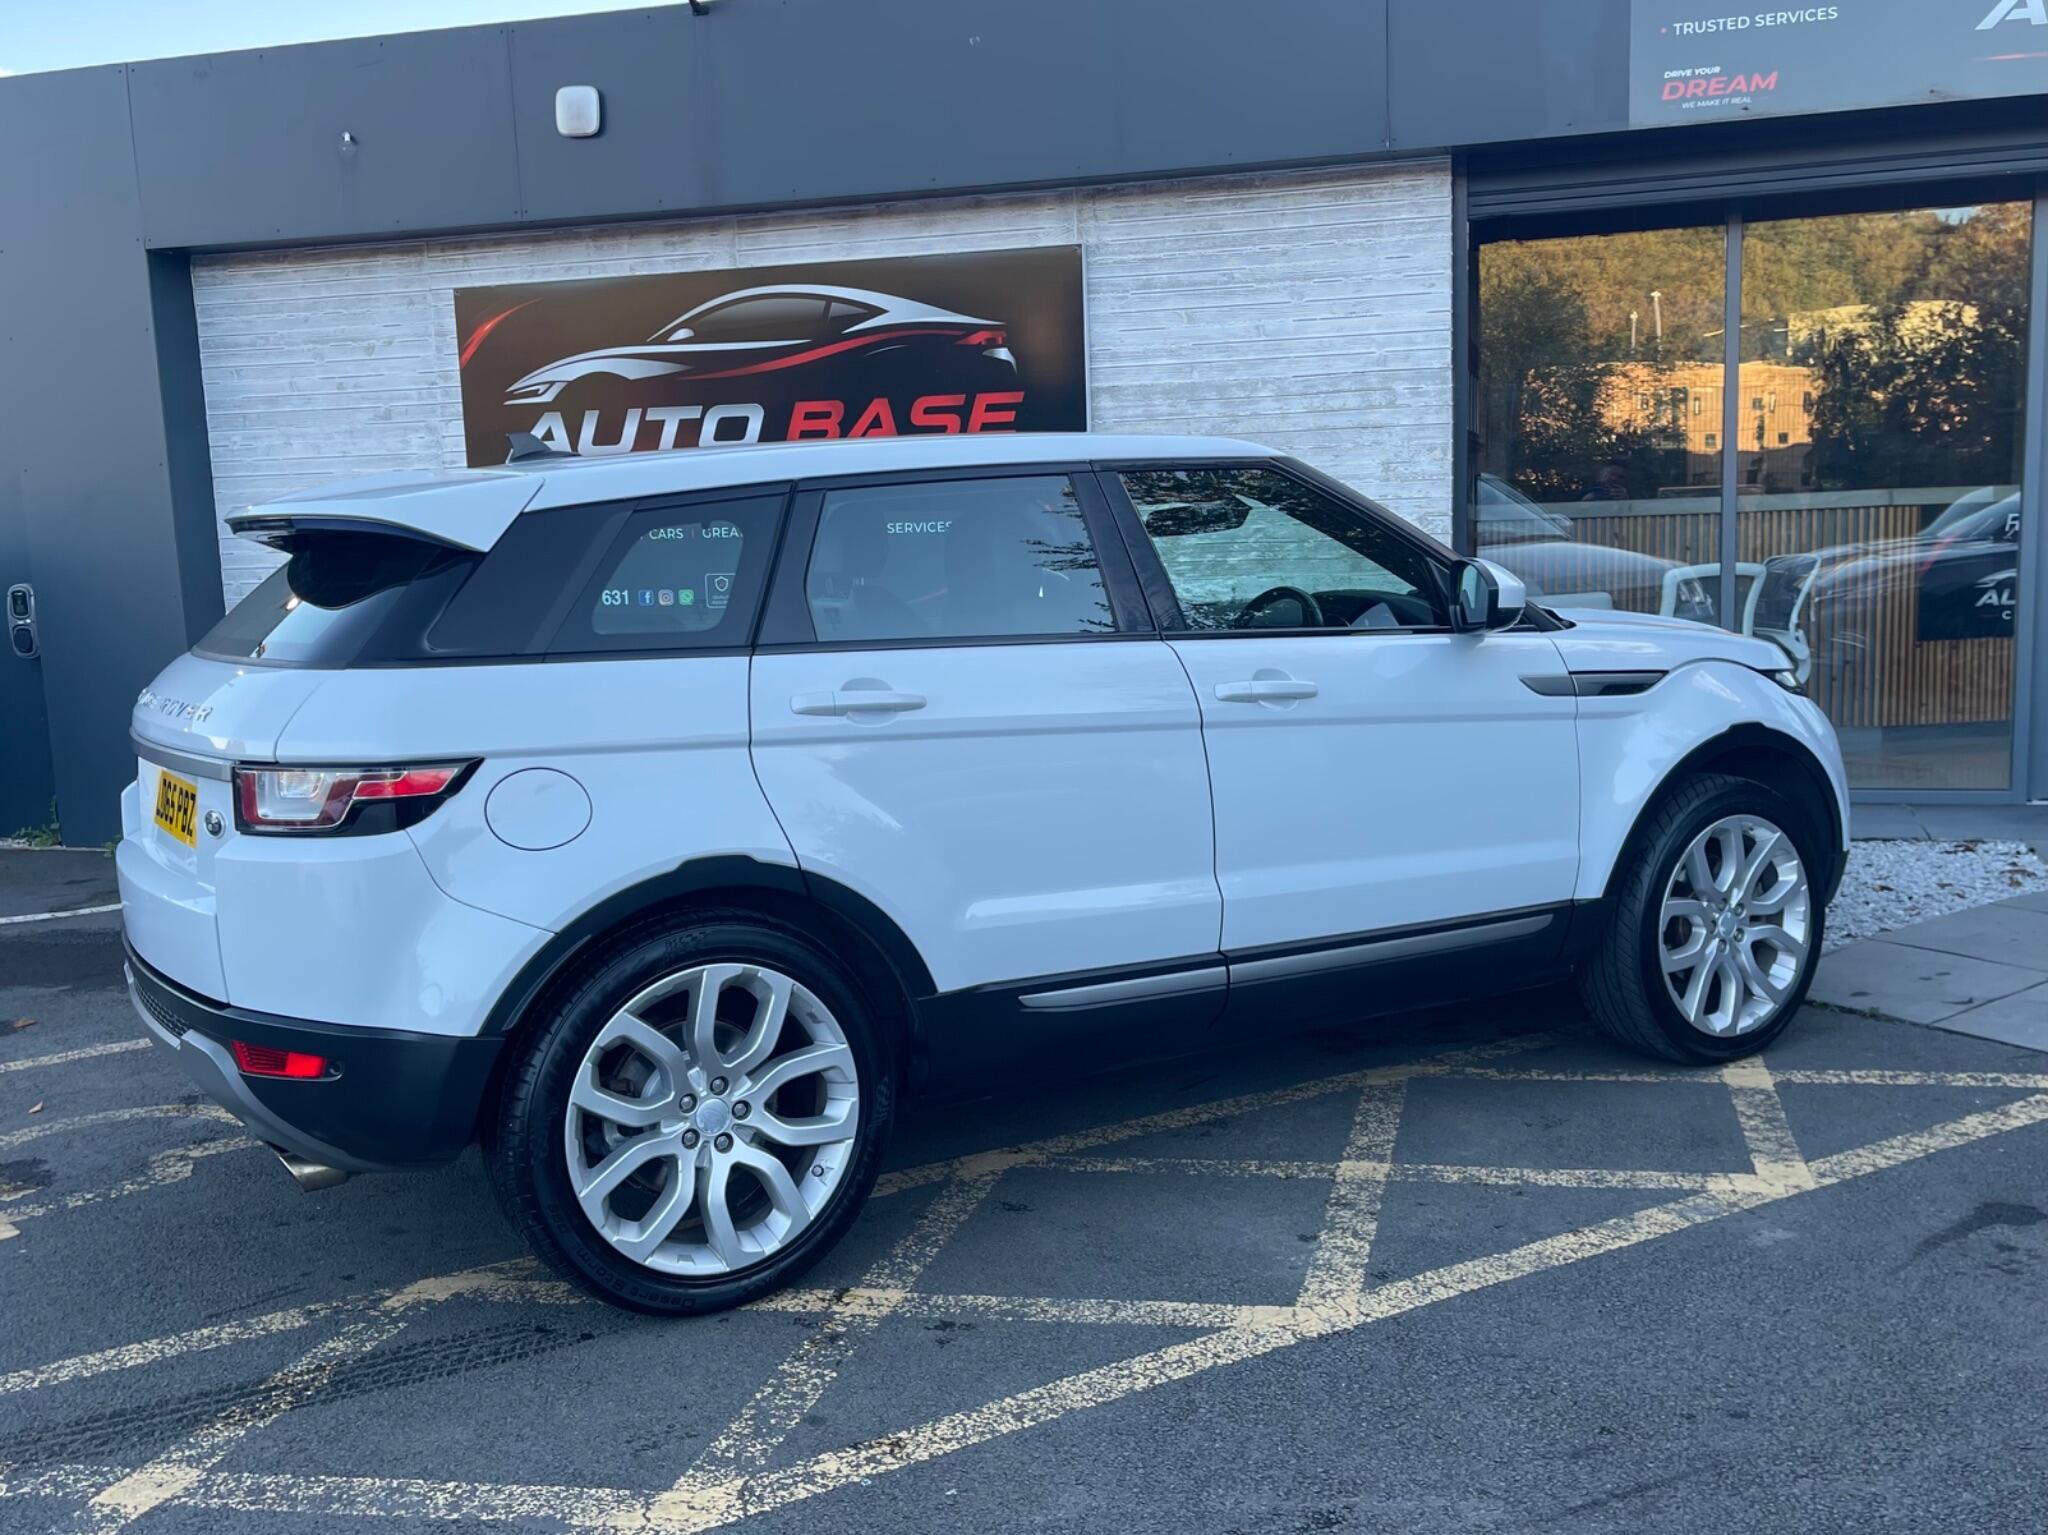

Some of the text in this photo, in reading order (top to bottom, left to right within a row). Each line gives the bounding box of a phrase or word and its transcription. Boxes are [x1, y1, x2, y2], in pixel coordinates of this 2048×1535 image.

[1673, 6, 1839, 36] TRUSTED SERVICES
[1664, 66, 1721, 79] DRIVE YOUR
[1661, 71, 1779, 101] DREAM
[1681, 100, 1696, 109] WE
[1697, 99, 1720, 107] MAKE
[1721, 97, 1730, 105] IT
[506, 390, 1026, 460] AUTO BASE
[648, 526, 744, 540] CARS GREA
[601, 588, 630, 606] 631
